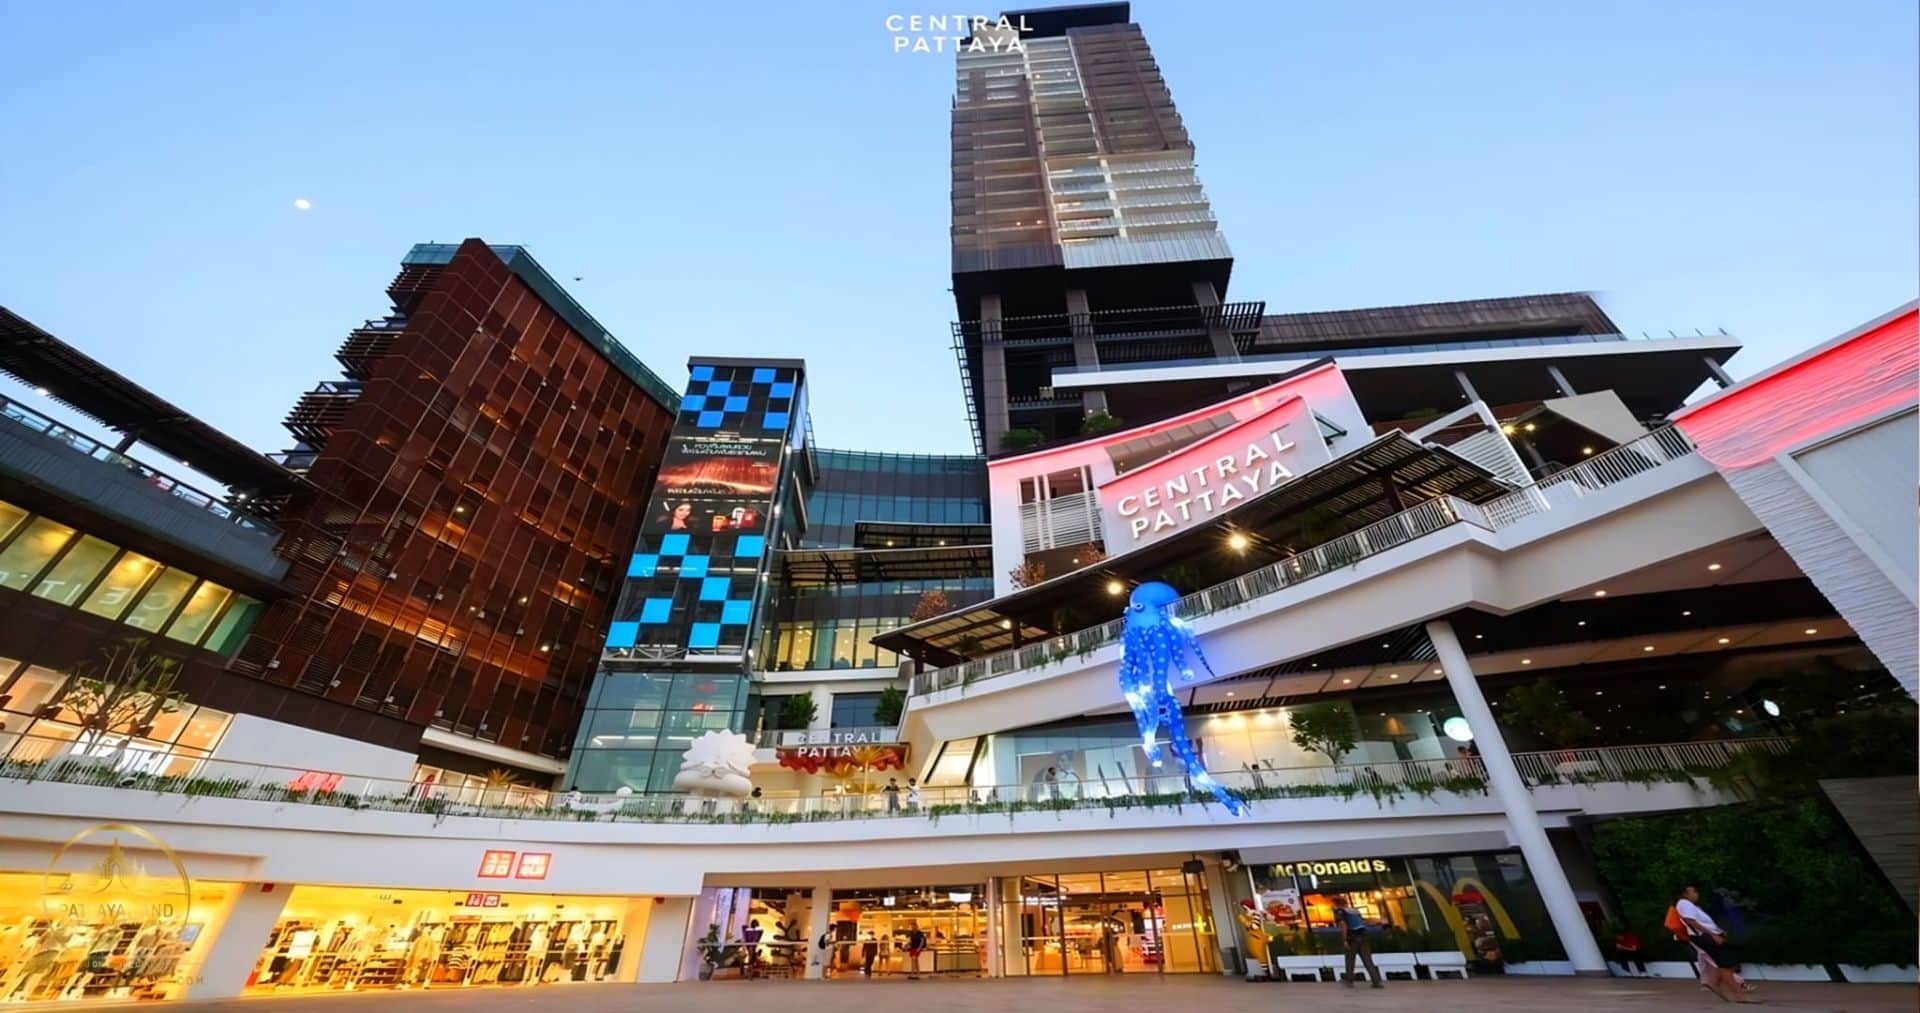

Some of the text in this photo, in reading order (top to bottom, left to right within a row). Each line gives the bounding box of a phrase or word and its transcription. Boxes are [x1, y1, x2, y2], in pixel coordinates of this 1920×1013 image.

[1118, 431, 1297, 516] CENTRAL
[1131, 461, 1294, 539] PATTAYA
[798, 732, 880, 745] CETRAL
